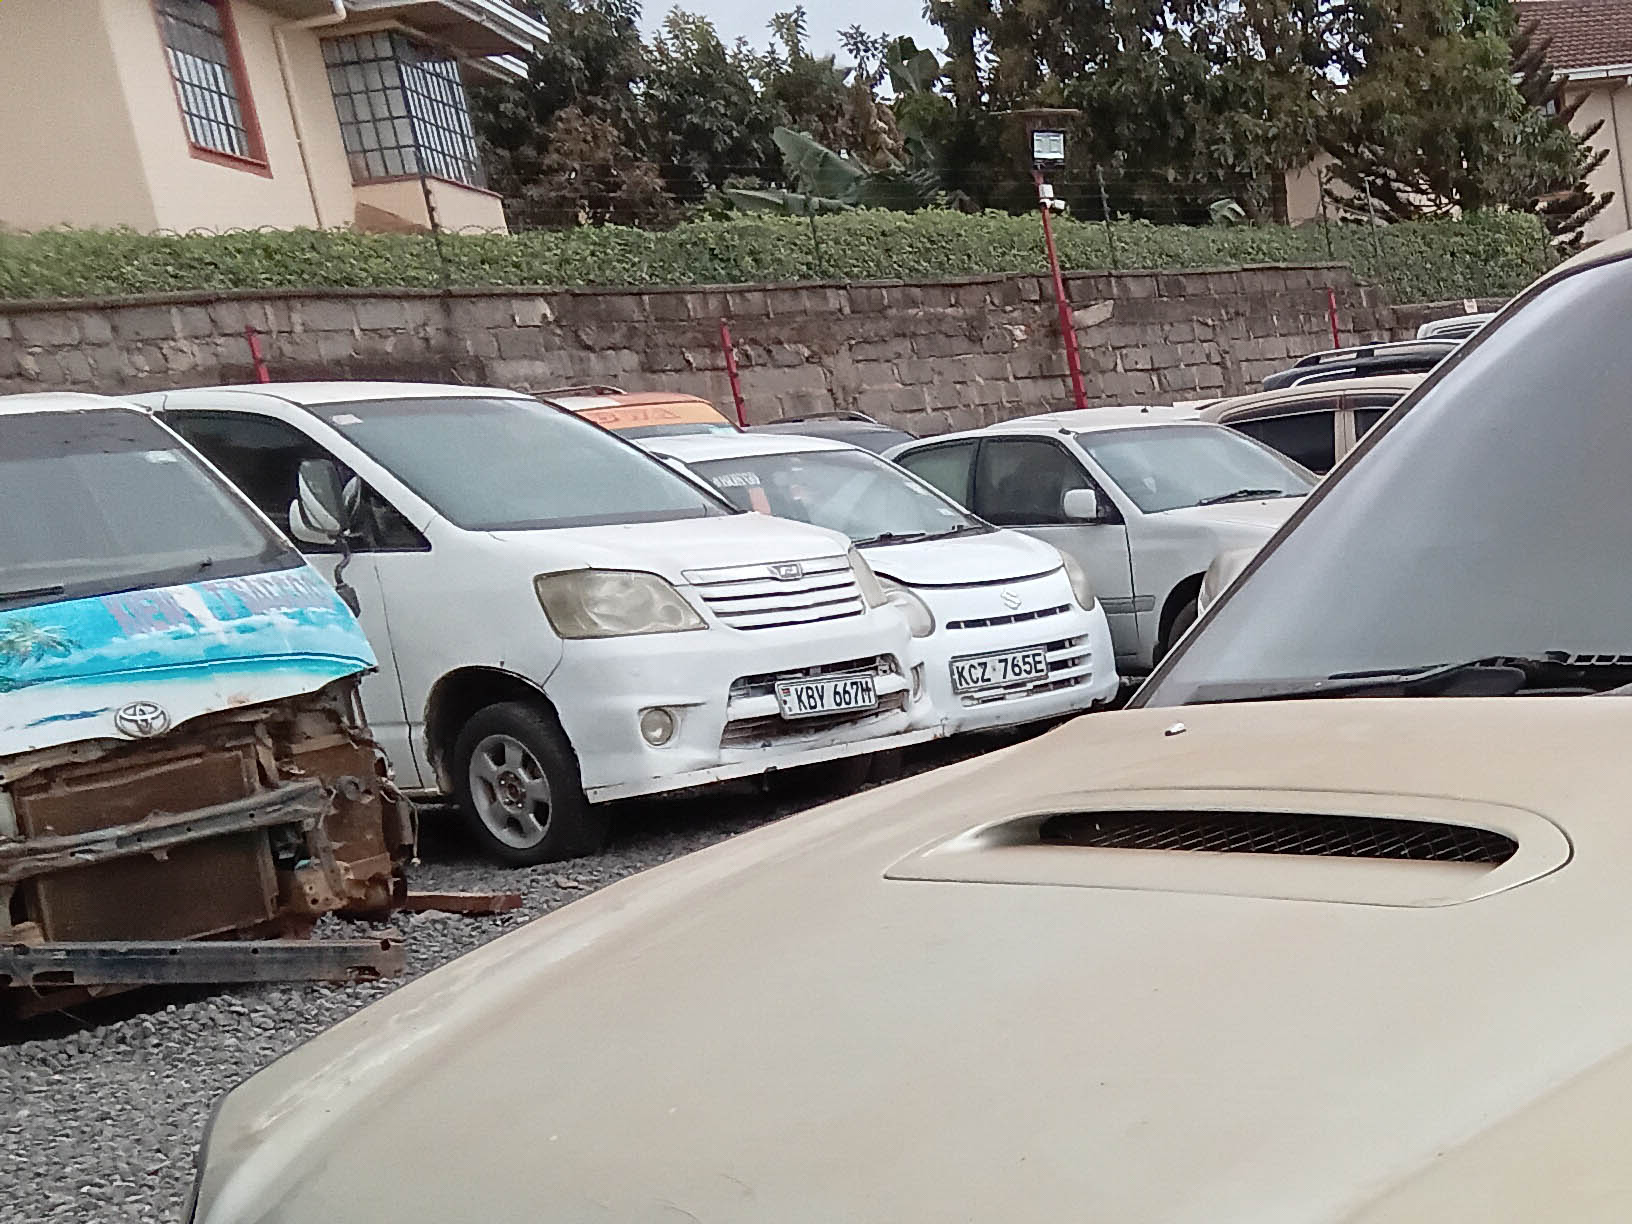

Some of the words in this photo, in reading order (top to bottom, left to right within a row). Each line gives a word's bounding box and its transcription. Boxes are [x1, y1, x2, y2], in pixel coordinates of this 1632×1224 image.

[955, 661, 992, 687] KCZ
[998, 652, 1045, 679] 765E
[794, 684, 825, 712] KBY
